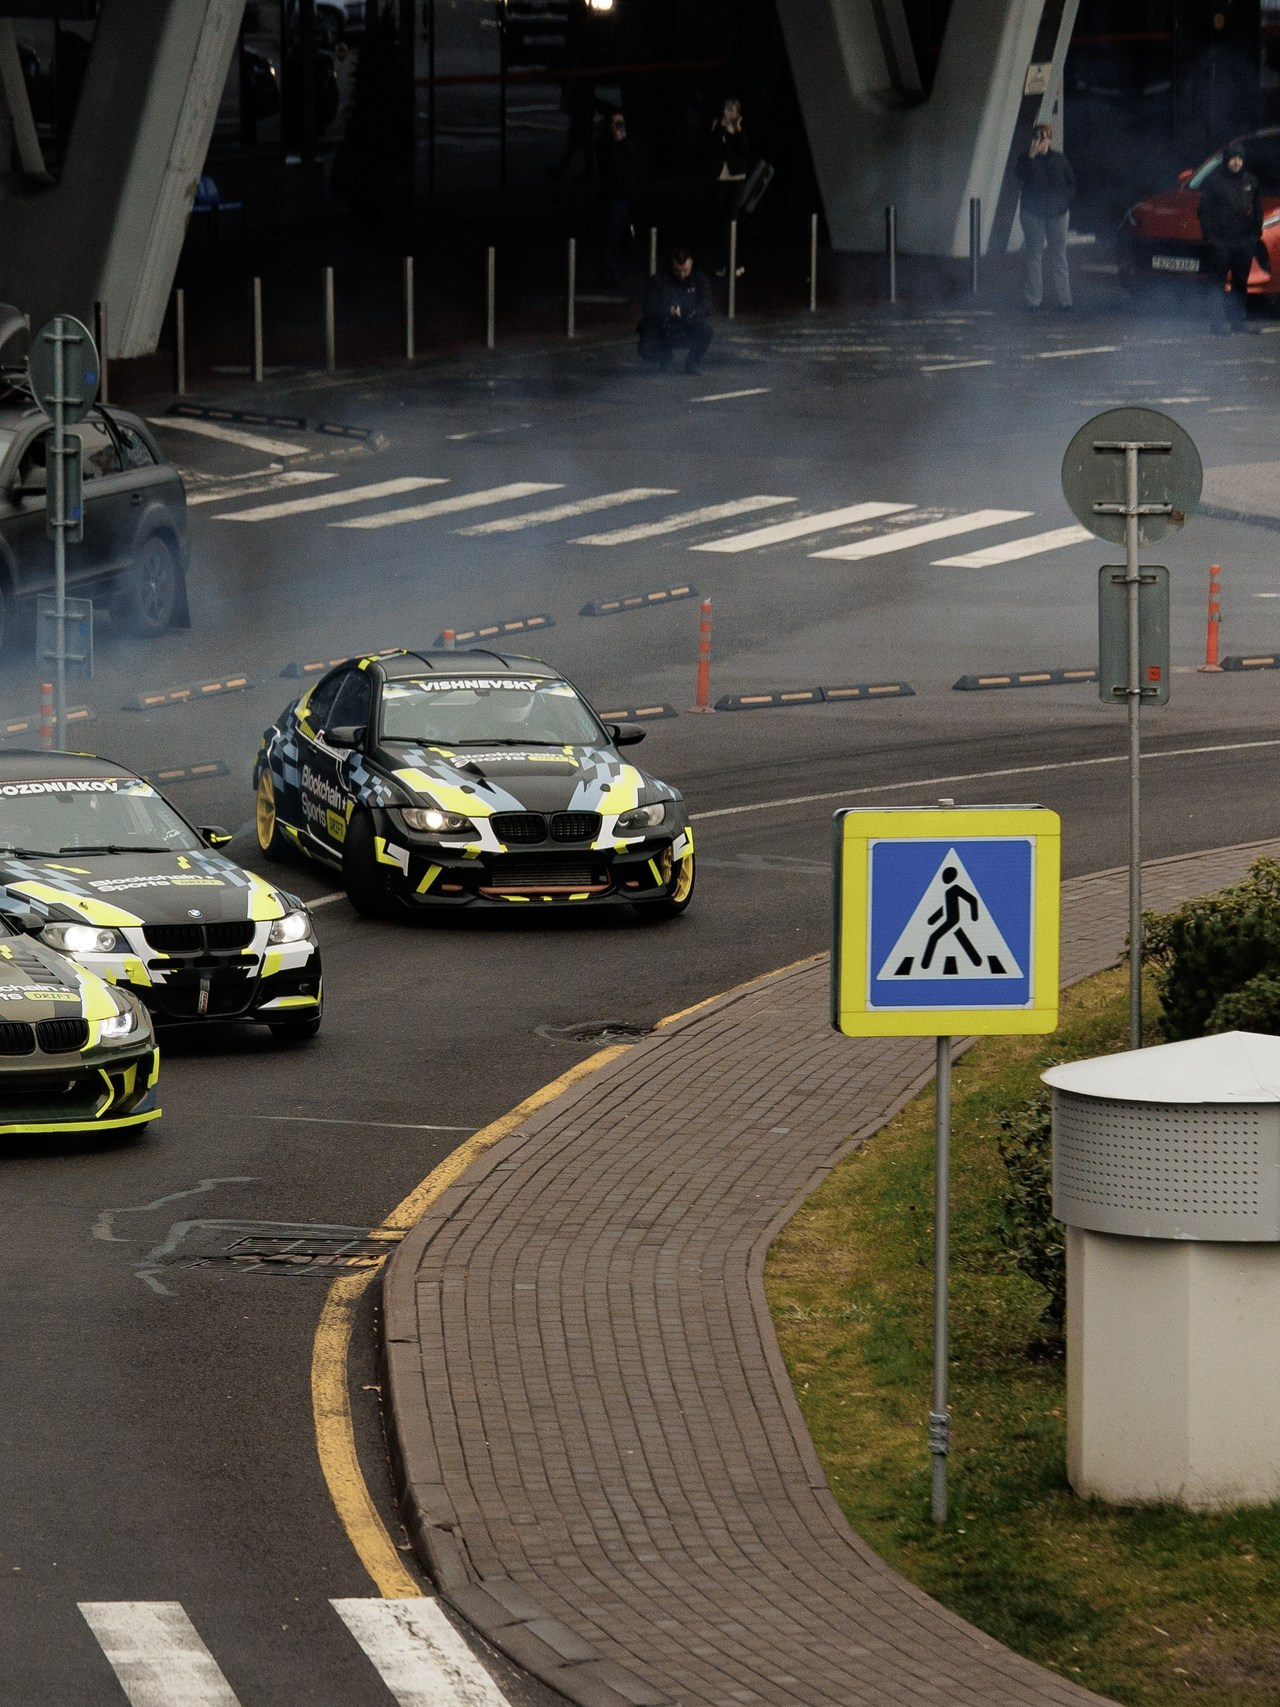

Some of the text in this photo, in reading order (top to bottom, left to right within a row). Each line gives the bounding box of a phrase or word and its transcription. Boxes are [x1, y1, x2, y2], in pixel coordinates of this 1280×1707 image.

[419, 680, 538, 691] VISHNEVSKY
[301, 764, 341, 811] Blockchain
[301, 791, 327, 827] Sports
[88, 874, 203, 888] Blockchain
